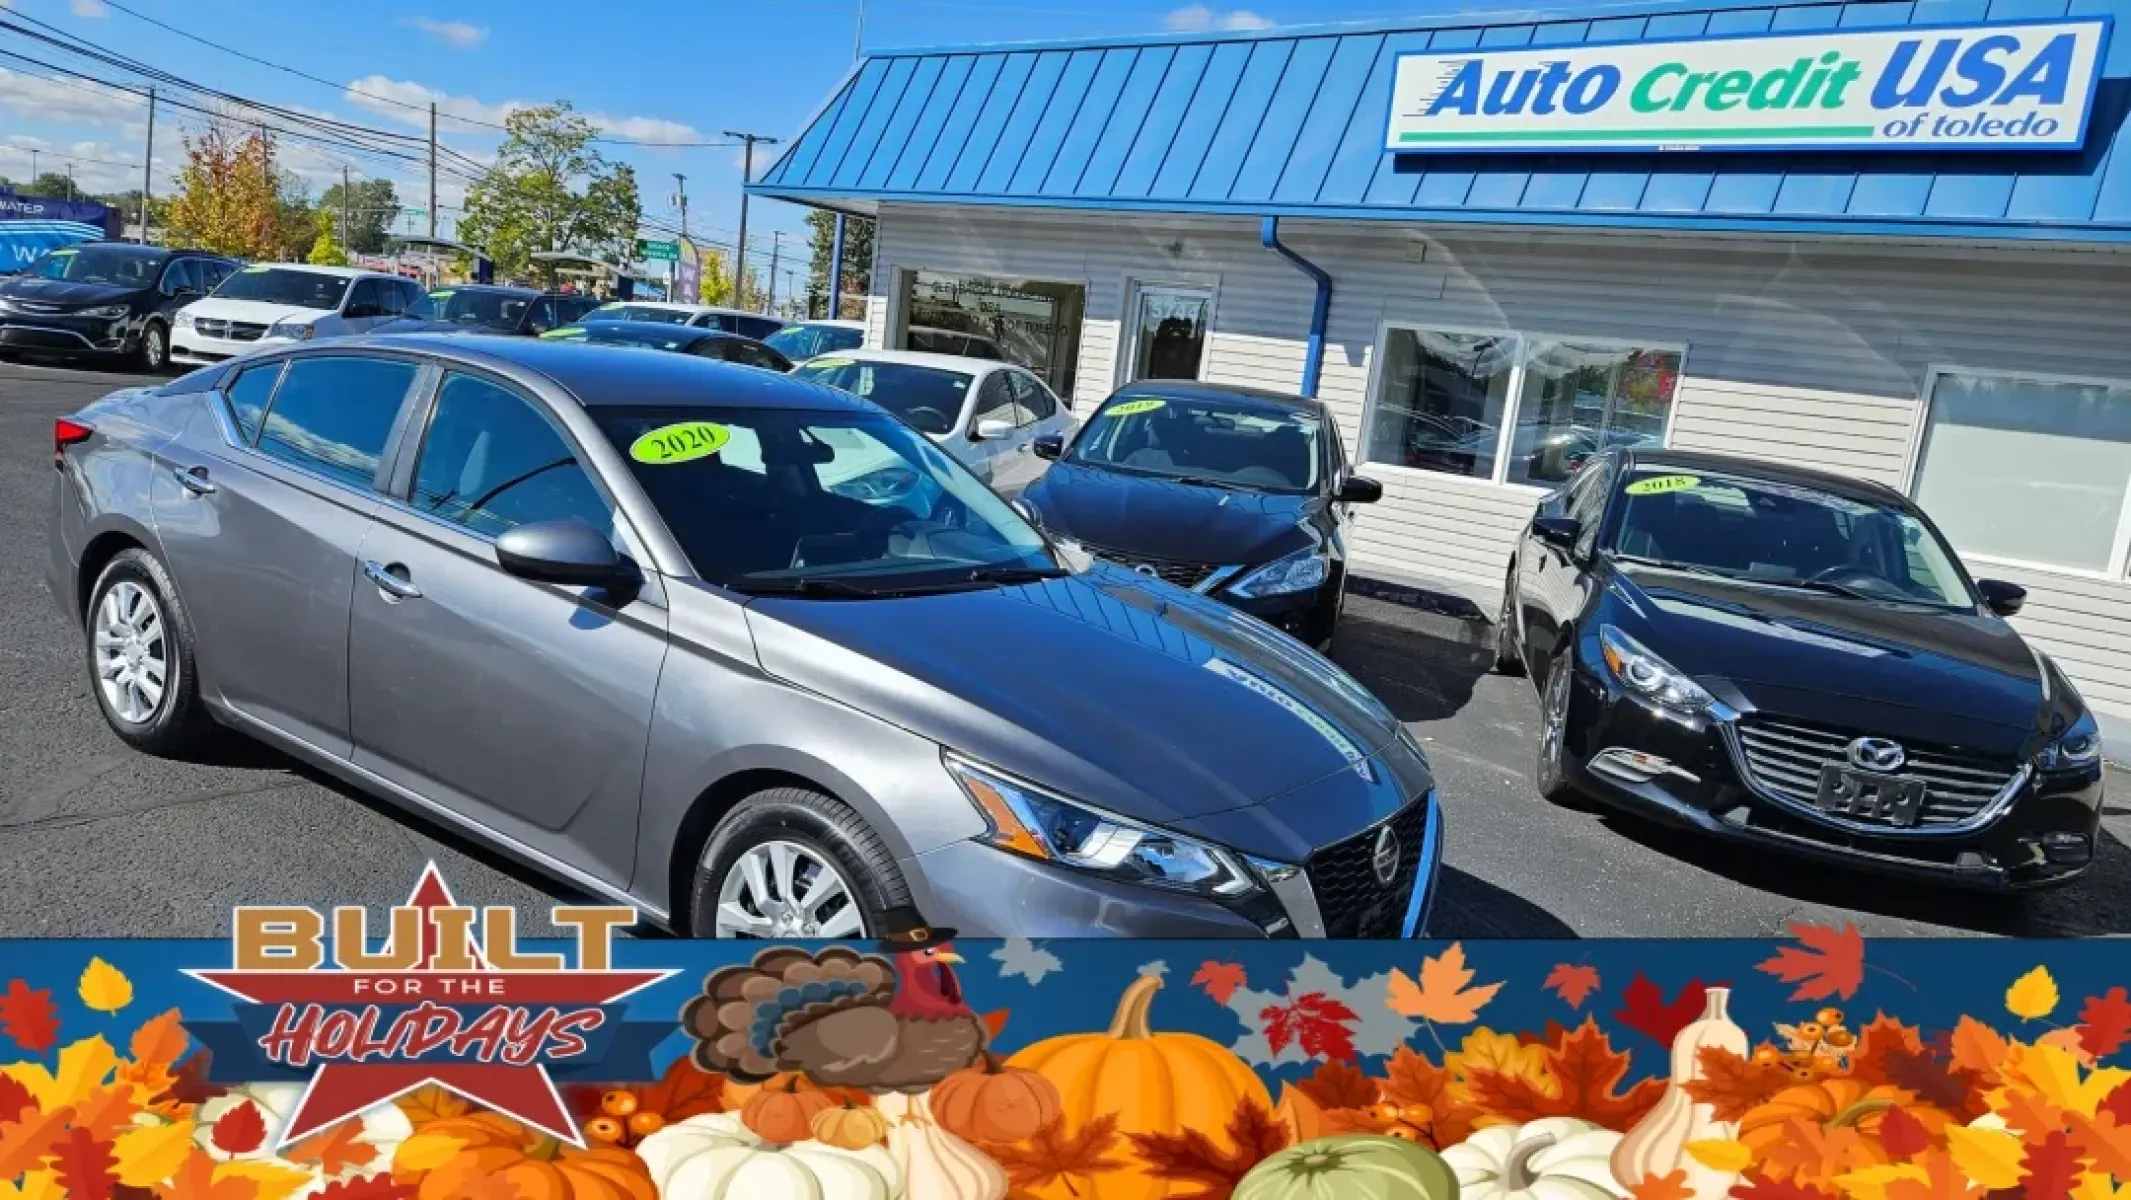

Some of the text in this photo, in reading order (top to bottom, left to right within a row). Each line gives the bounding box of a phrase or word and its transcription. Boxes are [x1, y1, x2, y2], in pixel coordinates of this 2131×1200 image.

[1420, 33, 2077, 117] Auto Credit USA
[1882, 111, 2059, 138] of toledo
[650, 425, 716, 459] 2020
